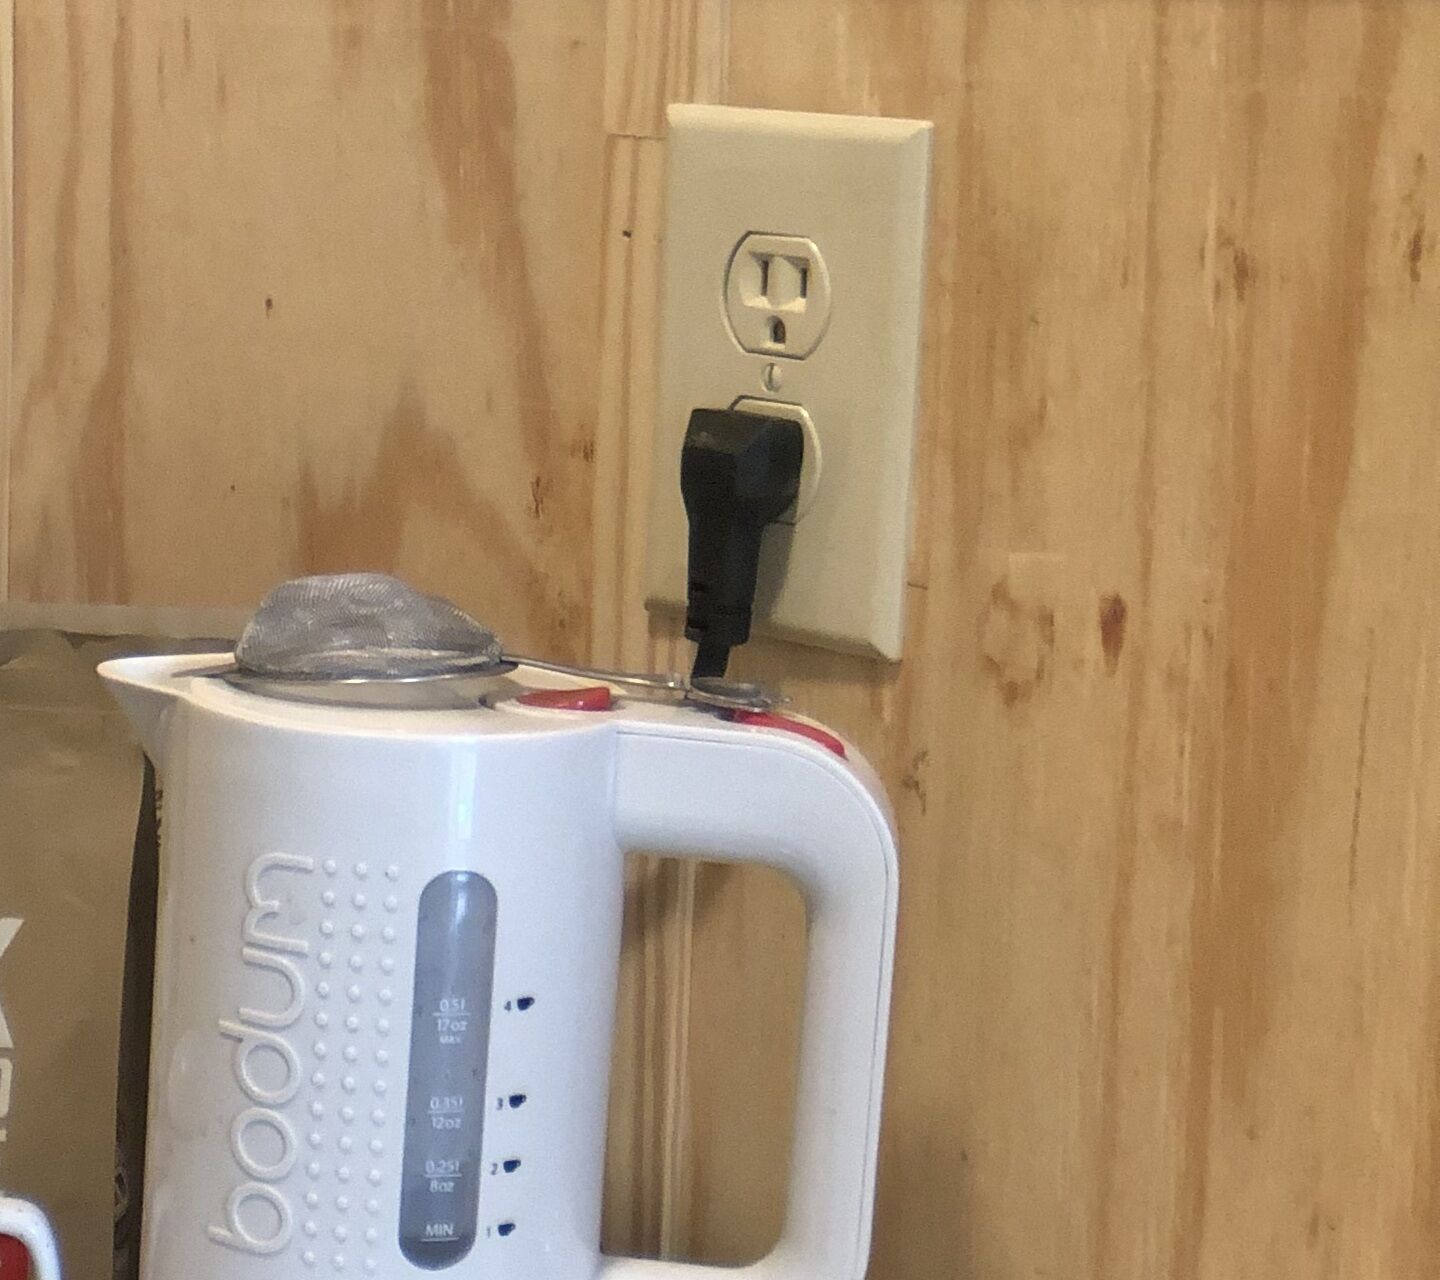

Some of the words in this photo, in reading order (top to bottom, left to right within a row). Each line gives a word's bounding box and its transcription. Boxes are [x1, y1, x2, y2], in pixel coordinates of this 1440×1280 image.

[208, 852, 315, 1255] bodum
[497, 1097, 504, 1111] 3
[490, 1163, 499, 1176] 2
[425, 1224, 454, 1237] MIN
